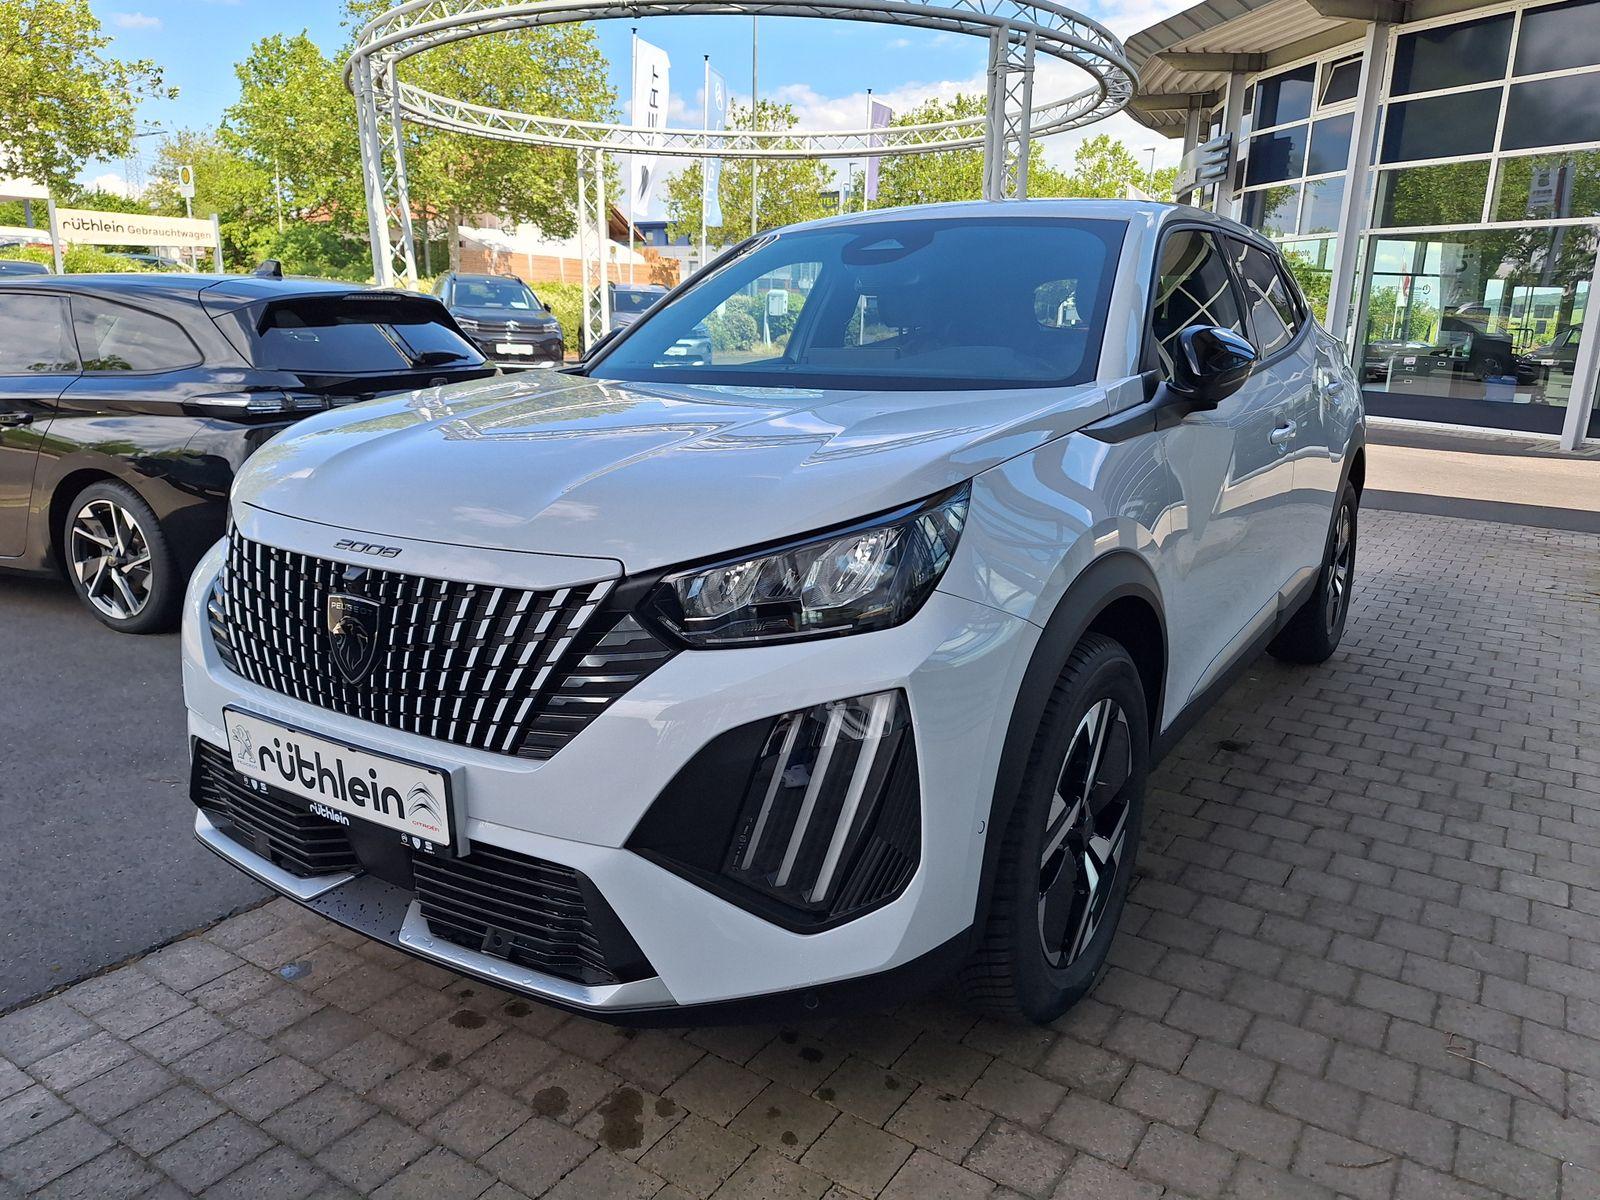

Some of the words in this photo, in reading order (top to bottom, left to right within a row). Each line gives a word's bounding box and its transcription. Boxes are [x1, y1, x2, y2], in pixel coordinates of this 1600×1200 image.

[63, 217, 125, 234] rüthlein
[127, 225, 212, 241] Gebrauchtwagen
[333, 538, 403, 558] 2008
[331, 601, 373, 615] PEUGEOT
[258, 737, 406, 820] rüthlein
[309, 802, 350, 826] rüthlein
